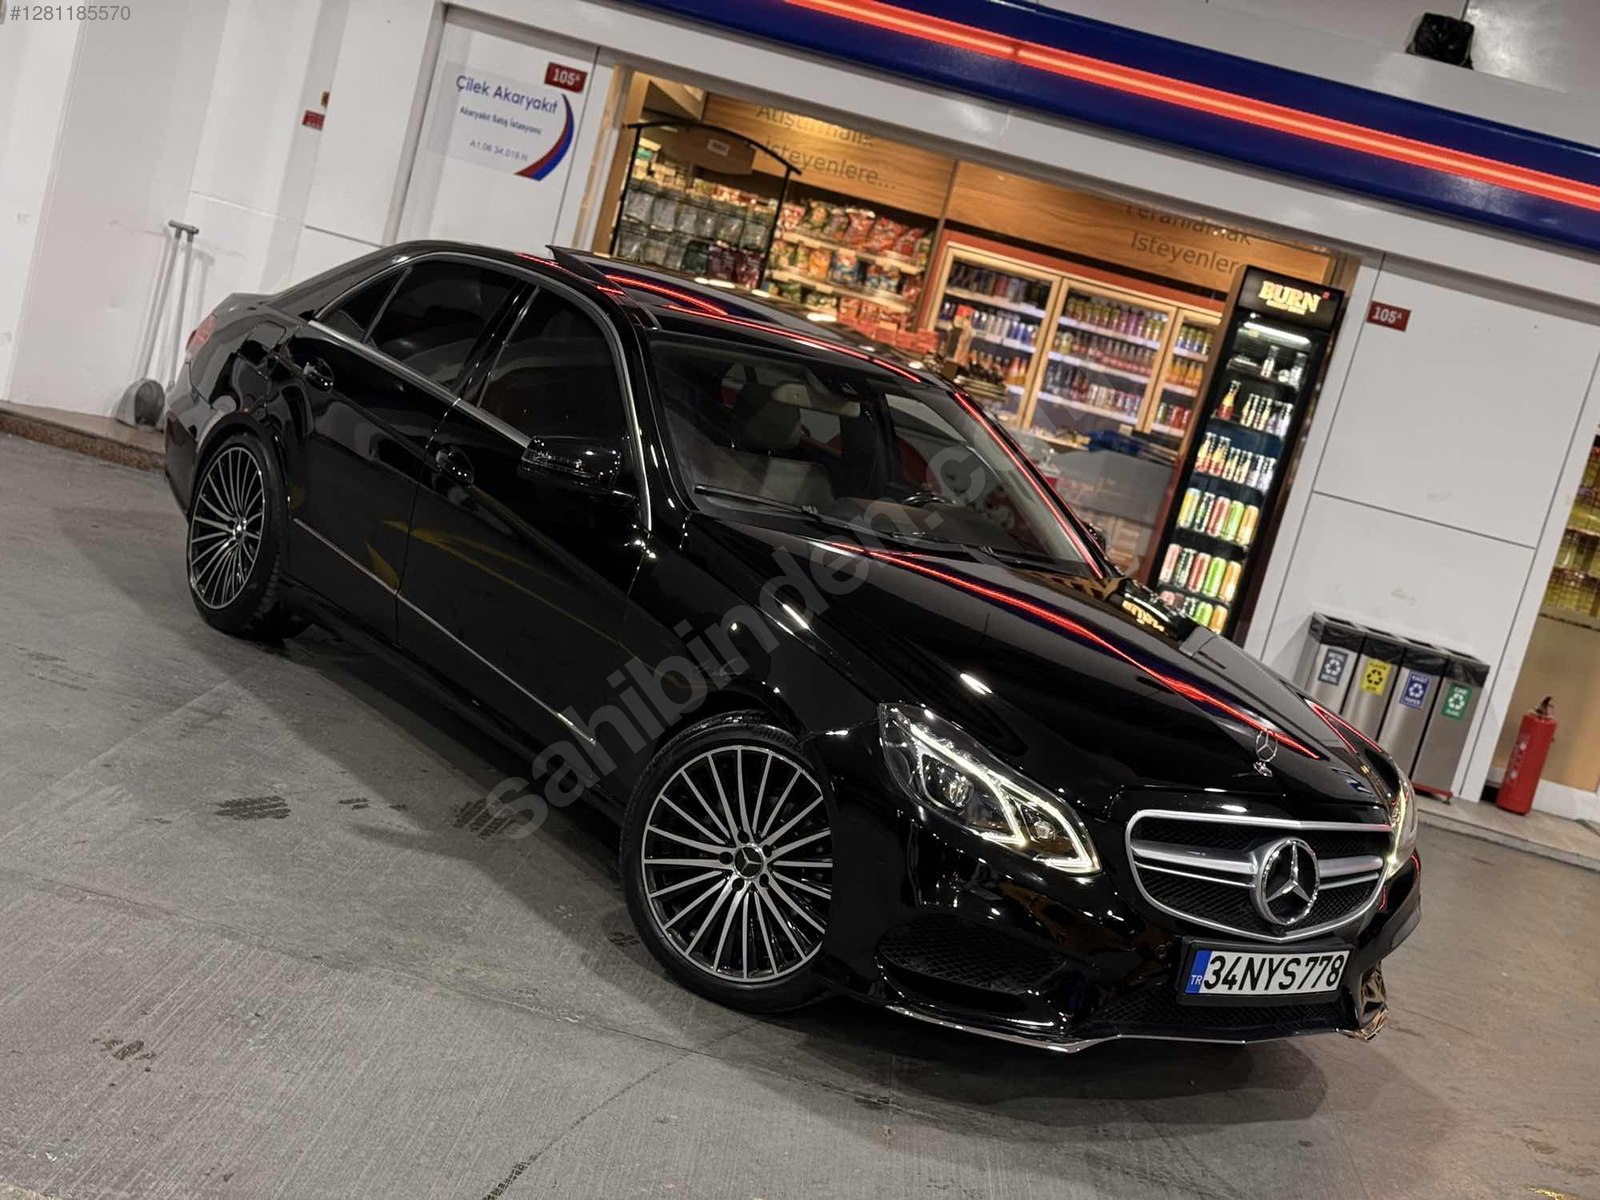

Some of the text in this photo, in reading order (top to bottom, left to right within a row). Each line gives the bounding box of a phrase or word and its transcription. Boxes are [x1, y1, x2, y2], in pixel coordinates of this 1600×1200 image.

[456, 75, 558, 114] Çilek Akaryakıt
[1258, 280, 1321, 313] BURN
[1190, 954, 1345, 991] TR 34NYS778
